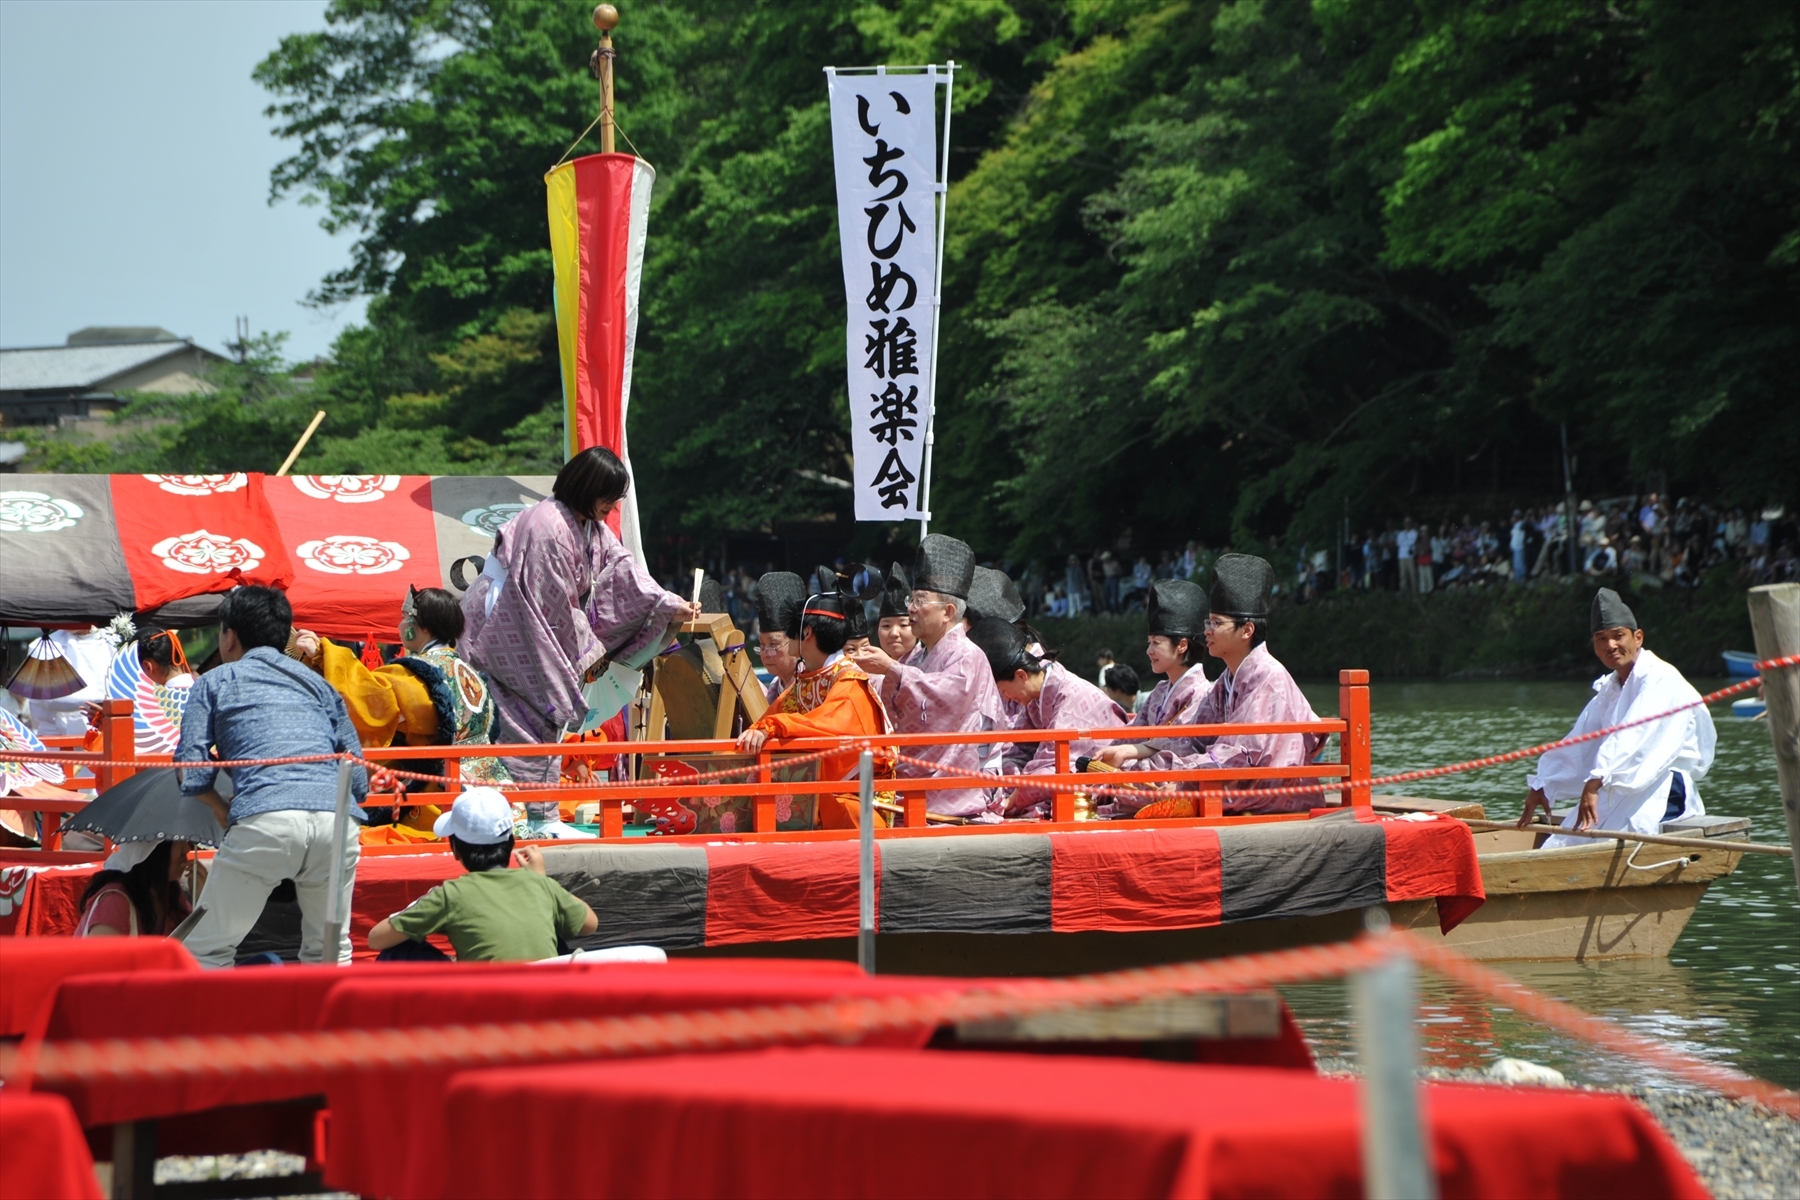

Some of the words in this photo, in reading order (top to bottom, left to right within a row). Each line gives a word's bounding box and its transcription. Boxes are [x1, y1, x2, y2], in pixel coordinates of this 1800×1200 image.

[855, 91, 918, 510] いちひめ雅楽会
